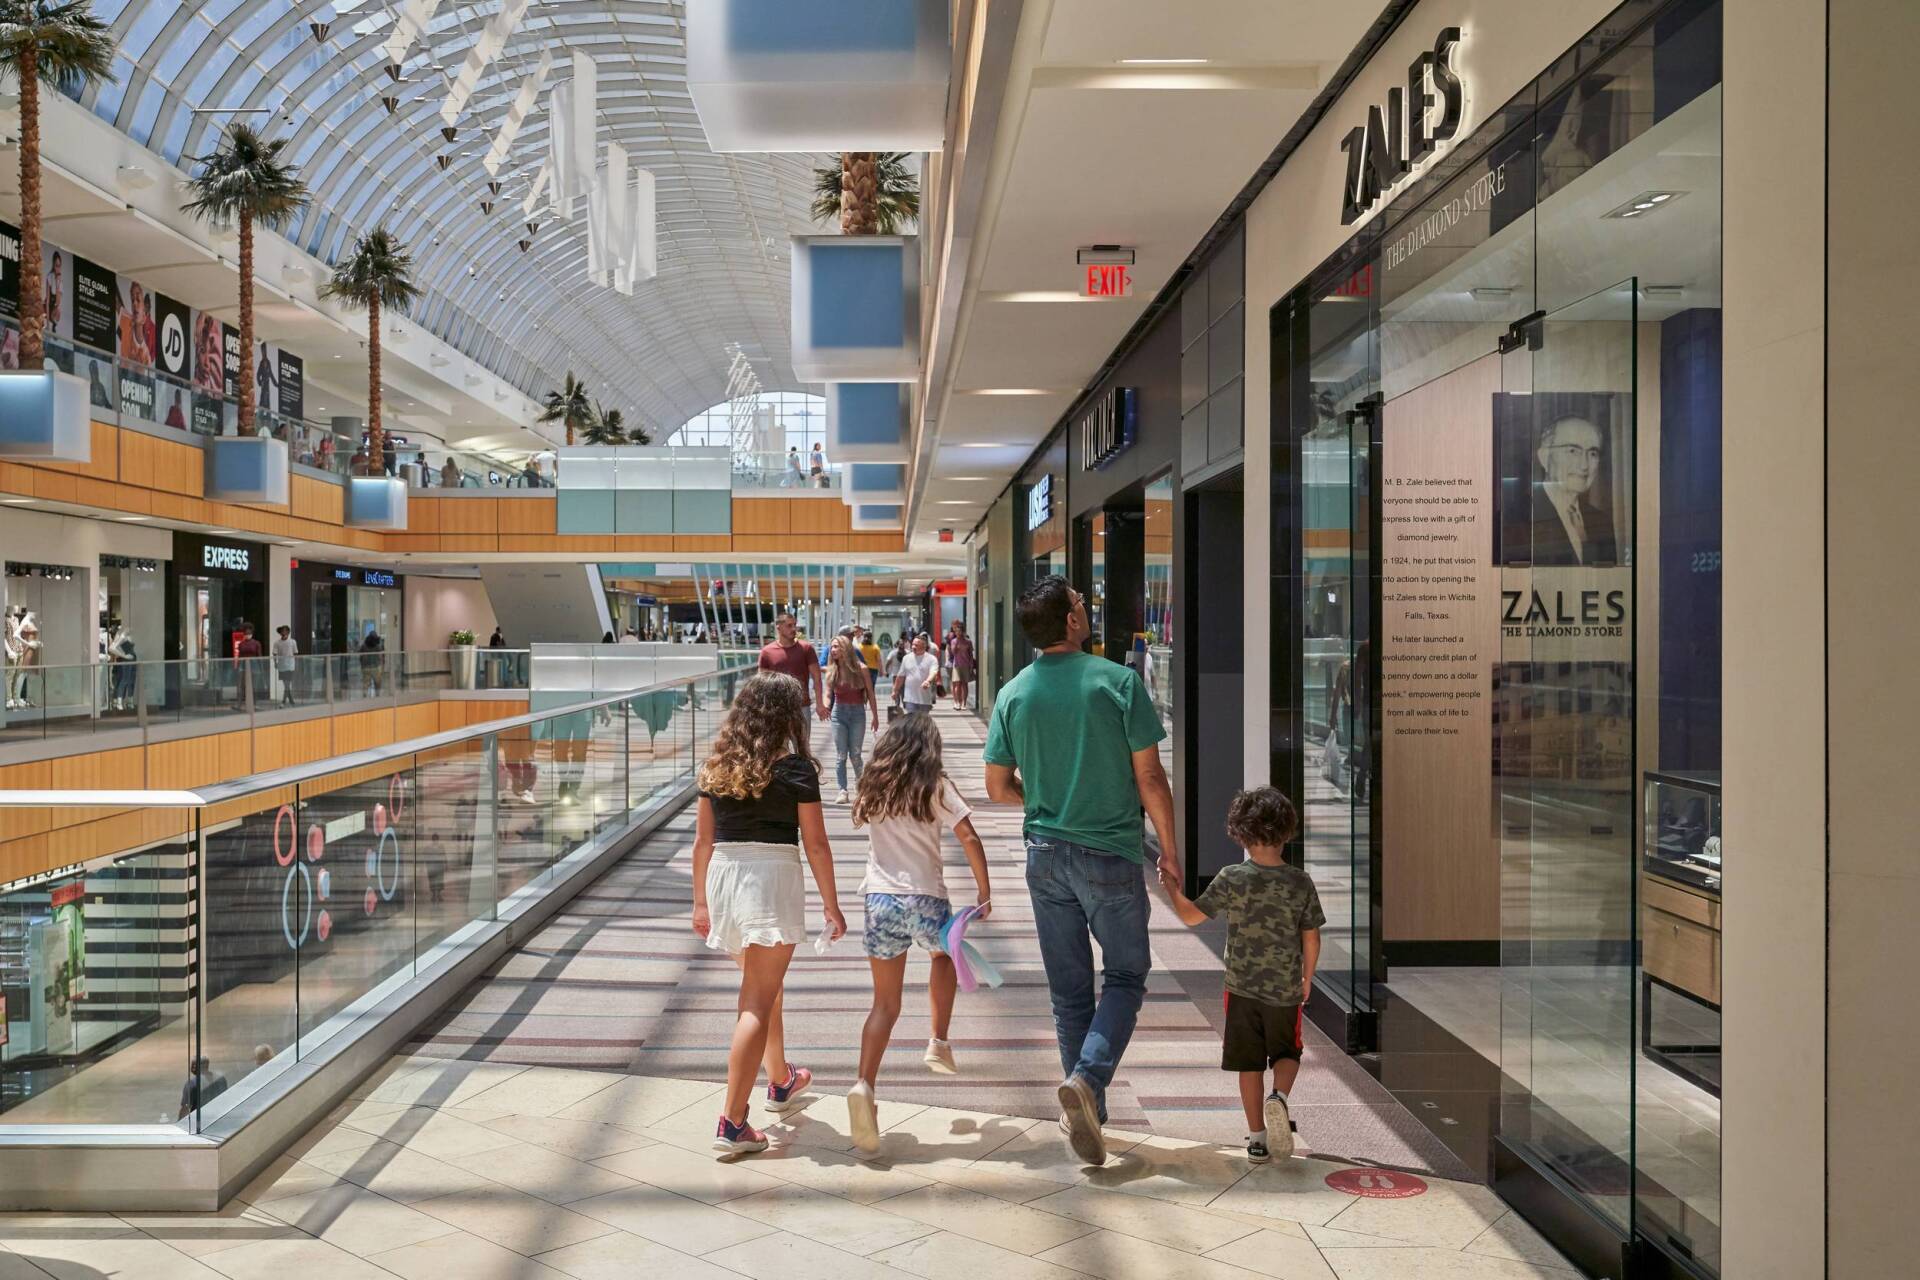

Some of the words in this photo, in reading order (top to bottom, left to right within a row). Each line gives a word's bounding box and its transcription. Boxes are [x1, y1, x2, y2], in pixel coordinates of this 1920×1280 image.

[1341, 26, 1462, 225] ZALES
[1386, 237, 1406, 271] THE
[1407, 198, 1460, 257] DIAMOND
[1464, 163, 1506, 217] STORE
[1087, 265, 1126, 296] EXIT
[79, 284, 95, 297] STYLES
[91, 280, 109, 295] GLOBAL
[164, 327, 182, 358] JD
[1406, 478, 1423, 486] Zale
[1425, 478, 1456, 486] believed
[1458, 478, 1473, 486] that
[1383, 498, 1413, 506] veryone
[1453, 516, 1467, 525] gift
[1397, 533, 1430, 541] diamond
[204, 545, 249, 571] EXPRESS
[1424, 558, 1437, 566] put
[1420, 576, 1431, 585] by
[1431, 576, 1462, 585] opening
[1395, 593, 1417, 601] Zales
[1439, 593, 1447, 601] in
[1447, 593, 1476, 601] Wichita
[1501, 590, 1625, 625] ZALES
[1584, 626, 1623, 637] STORE
[1392, 635, 1403, 643] He
[1404, 634, 1422, 643] later
[1423, 634, 1458, 643] launched
[1451, 654, 1468, 663] plan
[1412, 672, 1433, 680] down
[1457, 672, 1478, 680] dollar
[1408, 691, 1454, 699] empowering
[1455, 691, 1481, 699] people
[1387, 709, 1405, 717] from
[1405, 709, 1415, 717] all
[1416, 709, 1437, 717] walks
[1439, 709, 1447, 717] of
[1448, 709, 1460, 717] life
[1461, 709, 1470, 717] to
[1394, 727, 1423, 736] declare
[1424, 727, 1441, 736] their
